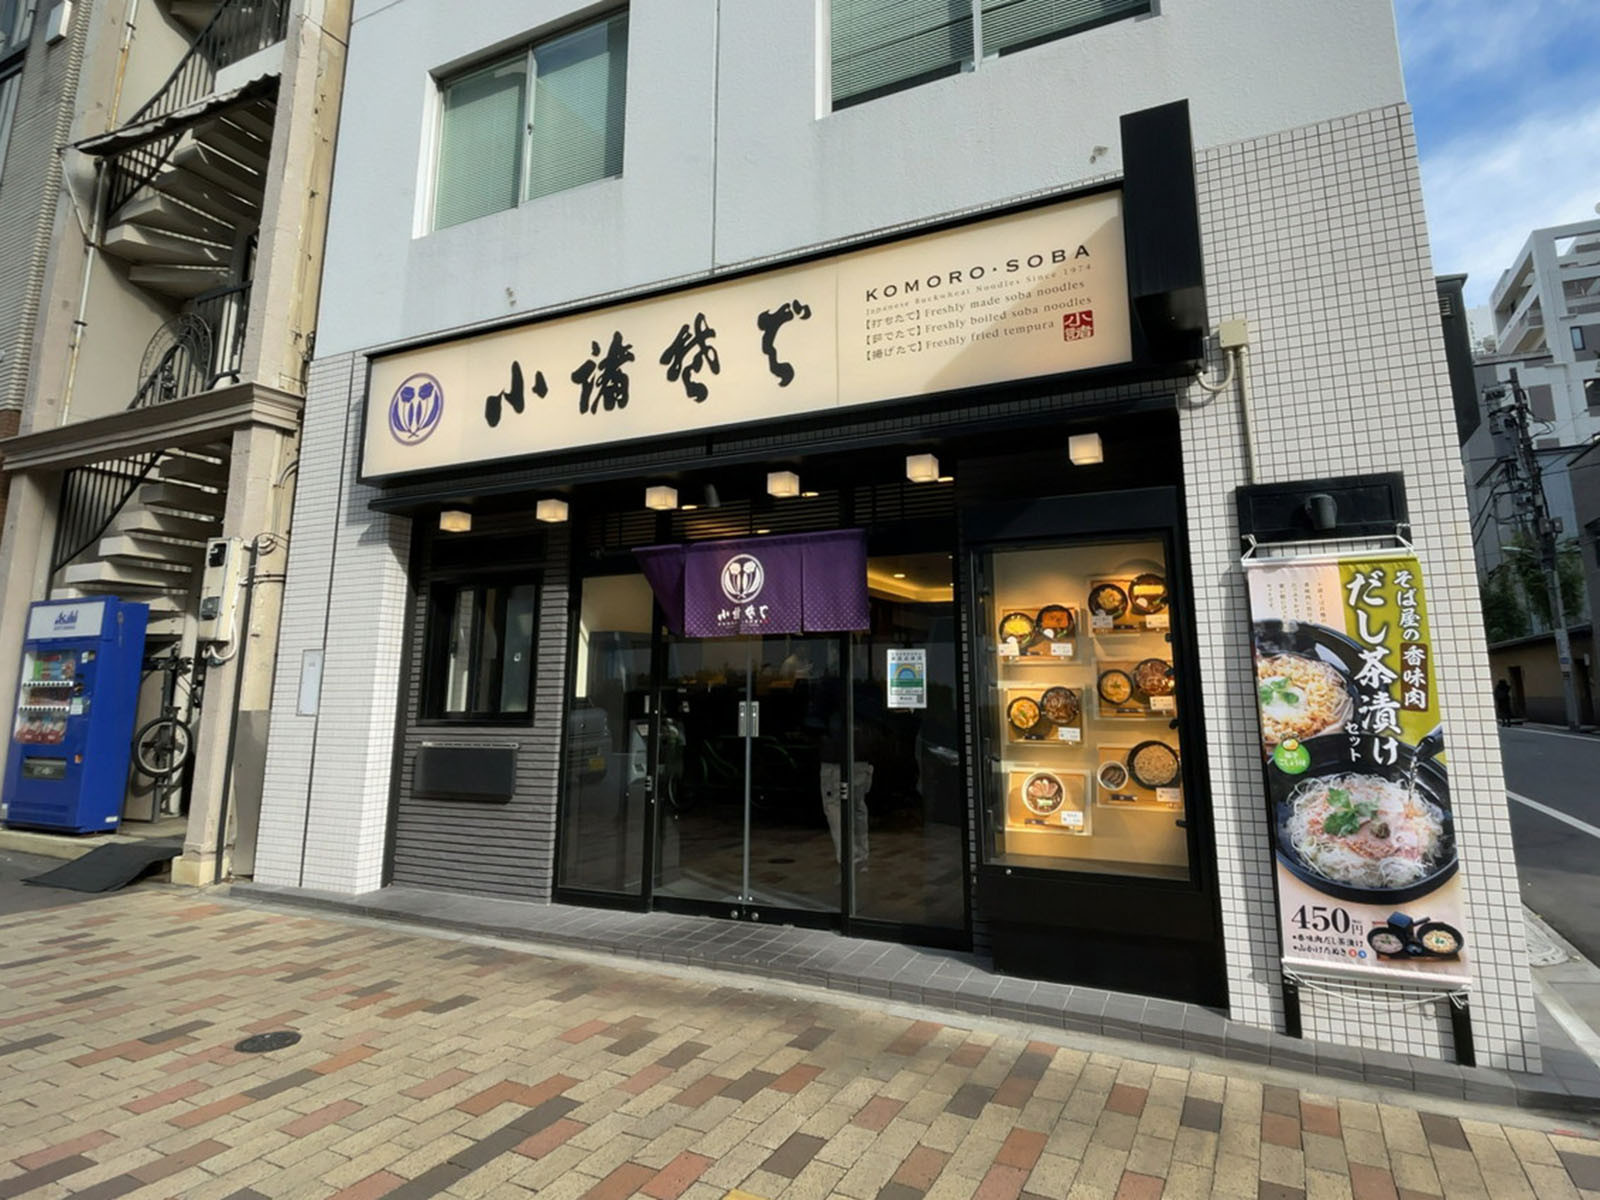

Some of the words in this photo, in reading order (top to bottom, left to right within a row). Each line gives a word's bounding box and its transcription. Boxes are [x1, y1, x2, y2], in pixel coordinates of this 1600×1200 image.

[914, 288, 970, 304] Buckwheat
[976, 279, 1020, 292] Noodles
[1026, 272, 1057, 283] Since
[925, 303, 965, 318] Freshly
[970, 296, 1001, 309] made
[1005, 291, 1032, 302] soba
[1037, 281, 1085, 297] noodles
[925, 319, 965, 334] Freshly
[970, 311, 1007, 325] boiled
[1012, 307, 1038, 318] soba
[1044, 297, 1092, 312] noodles
[926, 335, 967, 350] Freshly
[971, 328, 999, 341] fried
[1004, 320, 1054, 336] tempura
[1394, 570, 1421, 641] そば屋の
[1347, 569, 1402, 766] だし茶漬け
[1402, 645, 1427, 710] 香味肉
[1344, 721, 1362, 762] セット
